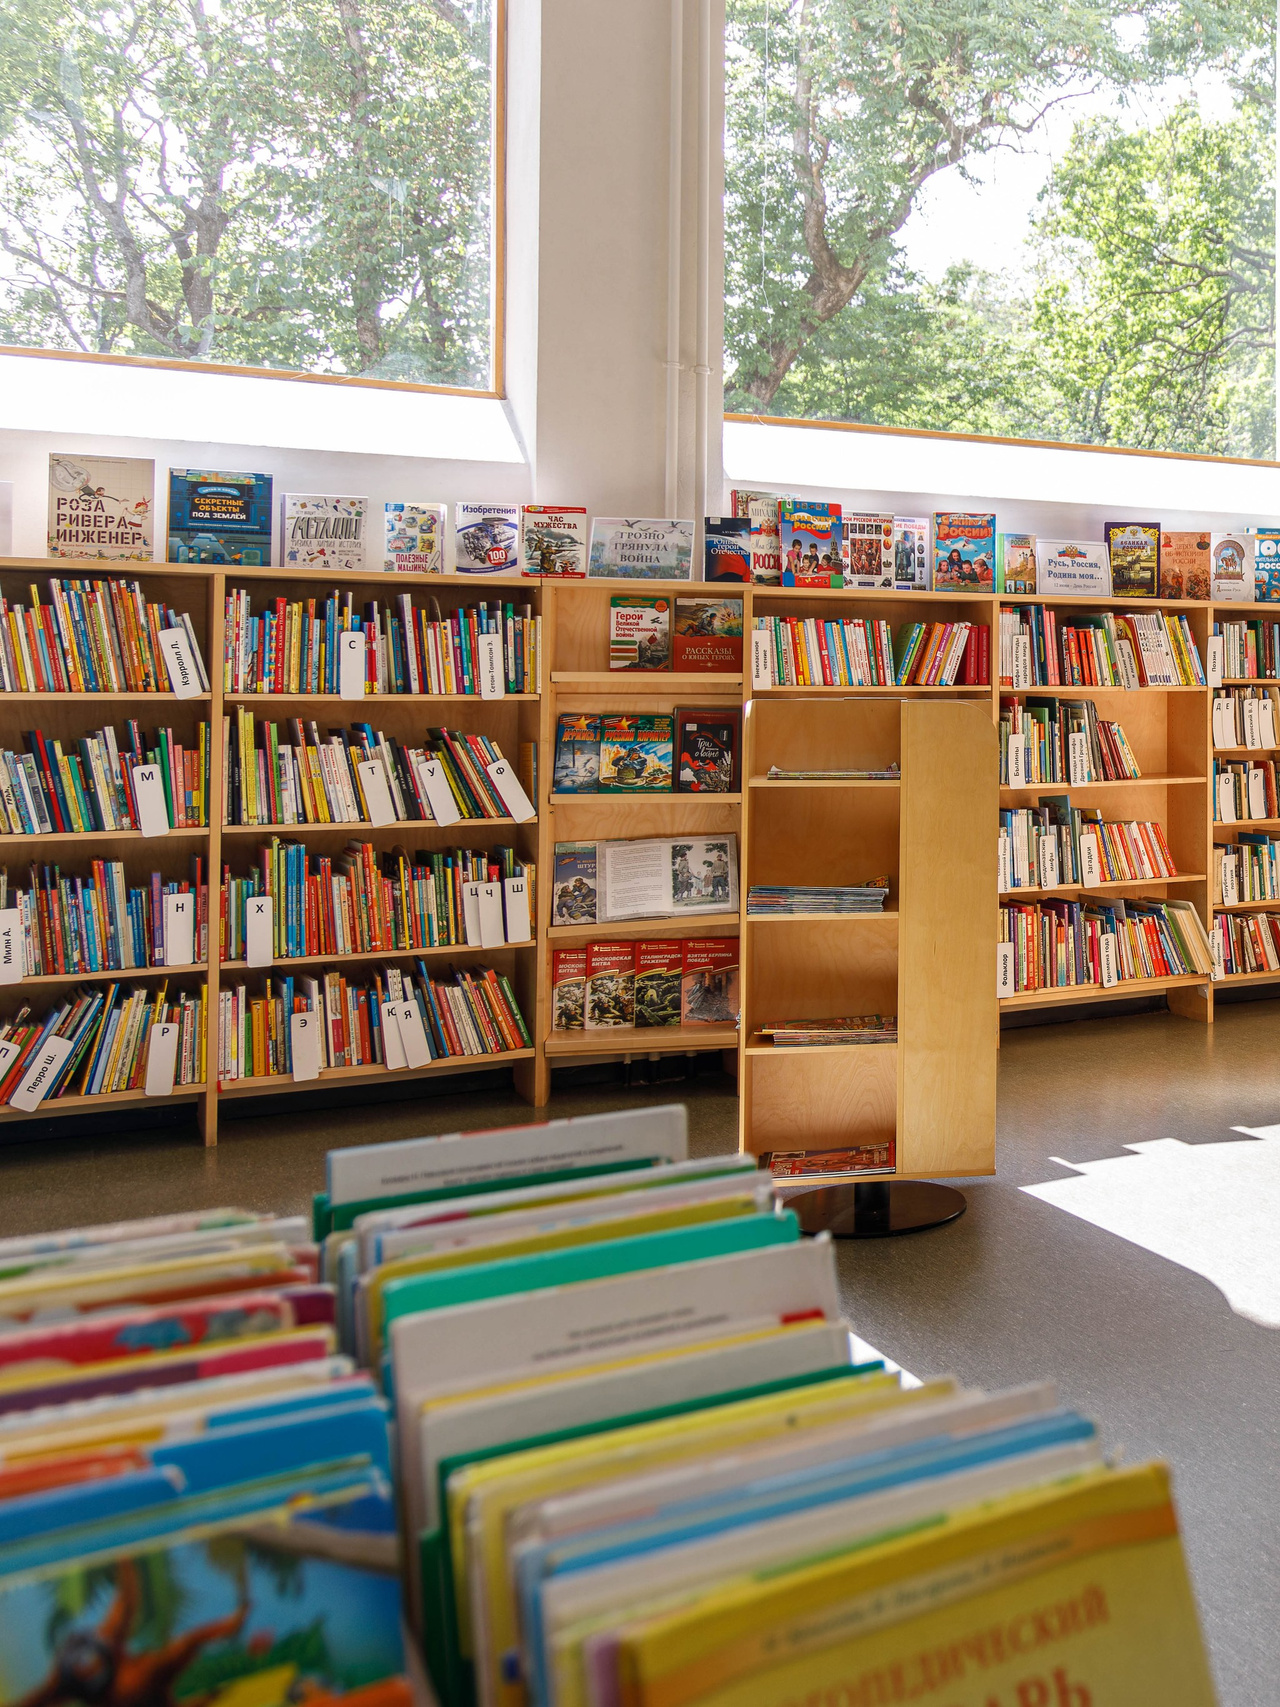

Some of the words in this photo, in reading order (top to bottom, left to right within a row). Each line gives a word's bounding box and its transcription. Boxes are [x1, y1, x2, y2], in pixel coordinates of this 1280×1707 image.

[56, 497, 106, 513] РОЗА
[194, 497, 244, 507] СЕКРЕТНЫЕ
[198, 505, 240, 513] ОБЪЕКТЫ
[462, 504, 517, 516] Изобретения
[192, 511, 210, 519] ПОД
[212, 511, 247, 521] ЗЕМЛЁЙ
[547, 515, 564, 523] ЧАС
[56, 513, 132, 531] РИВЕРА,
[533, 521, 578, 530] МУЖЕСТВА
[903, 522, 926, 530] ПОБЕДЫ
[291, 516, 363, 540] МЕТАЛЛЫ
[56, 529, 143, 546] ИНЖЕНЕР
[619, 532, 665, 540] ГРОЗНО
[614, 542, 669, 552] ГРЯНУЛА
[395, 553, 429, 563] ПОЛЕЗНЫЕ
[488, 550, 506, 559] 100
[620, 553, 661, 564] ВОЙНА
[397, 563, 427, 572] МАШИНЫ
[1047, 558, 1070, 568] Русь,
[1070, 560, 1101, 570] Россия,
[1047, 569, 1077, 580] Родина
[615, 611, 643, 622] Герои
[615, 625, 657, 634] Отечественной
[348, 640, 356, 650] С
[685, 647, 732, 655] РАССКАЗЫ
[174, 652, 190, 686] Кэрролл
[487, 647, 496, 693] Сетон-Томпсон
[604, 728, 635, 741] РУССКИЙ
[637, 729, 670, 742] ХАРАКТЕР
[368, 766, 376, 775] Т
[426, 767, 436, 777] У
[496, 766, 505, 775] Ф
[140, 771, 154, 782] М
[1086, 846, 1094, 875] Загадки
[470, 884, 479, 897] Ц
[512, 883, 524, 893] Ш
[485, 889, 493, 898] Ч
[176, 903, 184, 912] Н
[256, 904, 264, 913] Х
[2, 927, 12, 936] А.
[3, 937, 12, 964] Милн
[592, 954, 632, 962] МОСКОВСКАЯ
[404, 1009, 412, 1020] Я
[299, 1018, 308, 1027] Э
[161, 1027, 169, 1036] Р
[26, 1066, 49, 1093] Перро
[44, 1054, 57, 1065] Ш.
